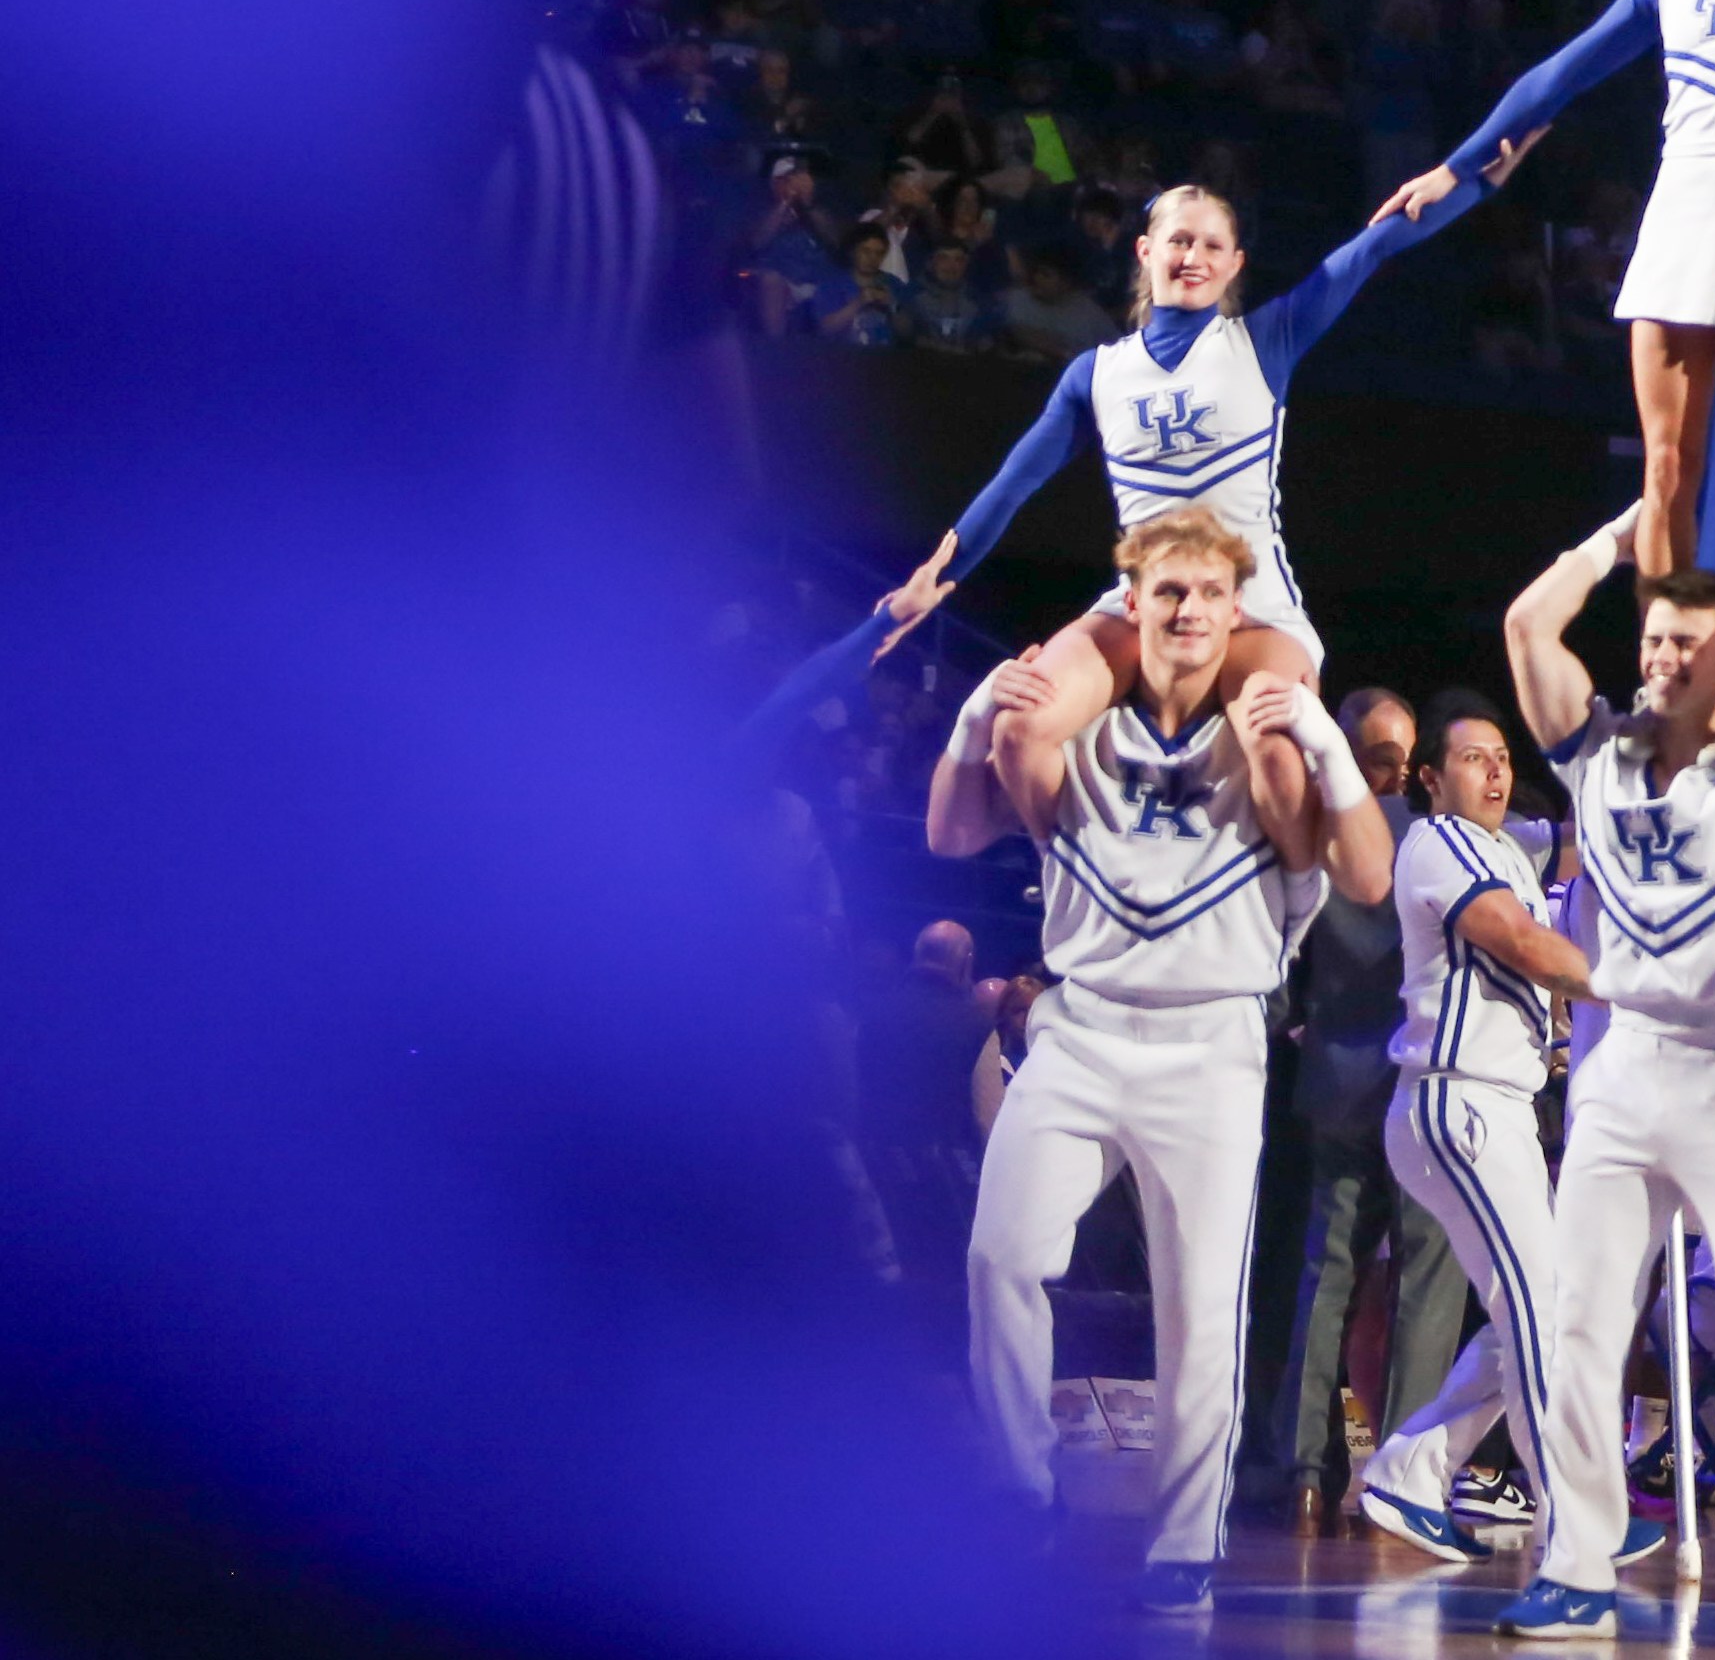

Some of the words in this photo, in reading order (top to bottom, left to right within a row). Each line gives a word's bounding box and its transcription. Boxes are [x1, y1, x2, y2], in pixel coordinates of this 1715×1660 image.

[1128, 384, 1223, 455] UK
[1115, 755, 1209, 841] UK
[1607, 803, 1707, 886] UK
